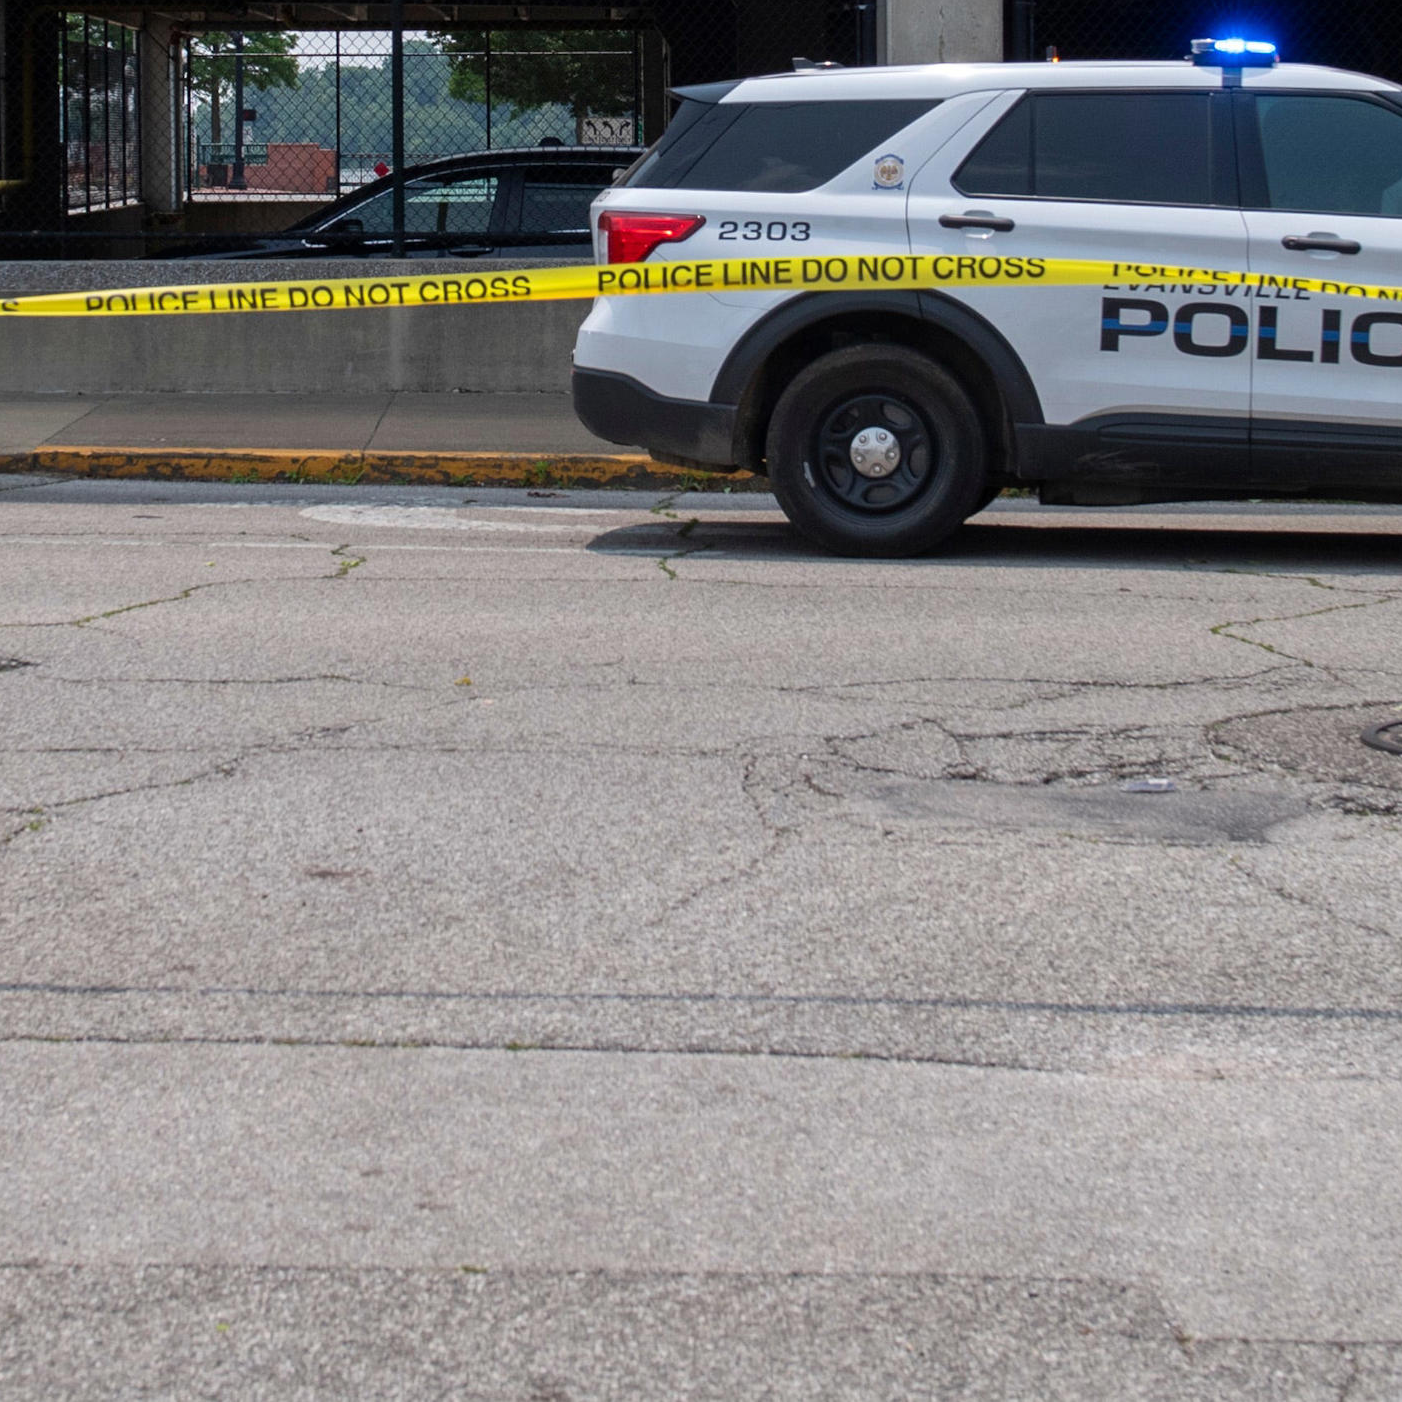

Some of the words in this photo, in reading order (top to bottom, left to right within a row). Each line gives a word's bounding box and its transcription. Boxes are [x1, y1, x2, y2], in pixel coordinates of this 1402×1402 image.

[718, 221, 811, 241] 2303
[598, 264, 713, 292] POLICE
[723, 259, 793, 286] LINE
[802, 257, 848, 284] DO
[858, 256, 925, 281] NOT
[932, 256, 1045, 280] CROSS
[86, 291, 198, 312] POLICE
[209, 288, 280, 310] LINE
[288, 286, 334, 309] DO
[344, 283, 410, 306] NOT
[418, 275, 531, 303] CROSS
